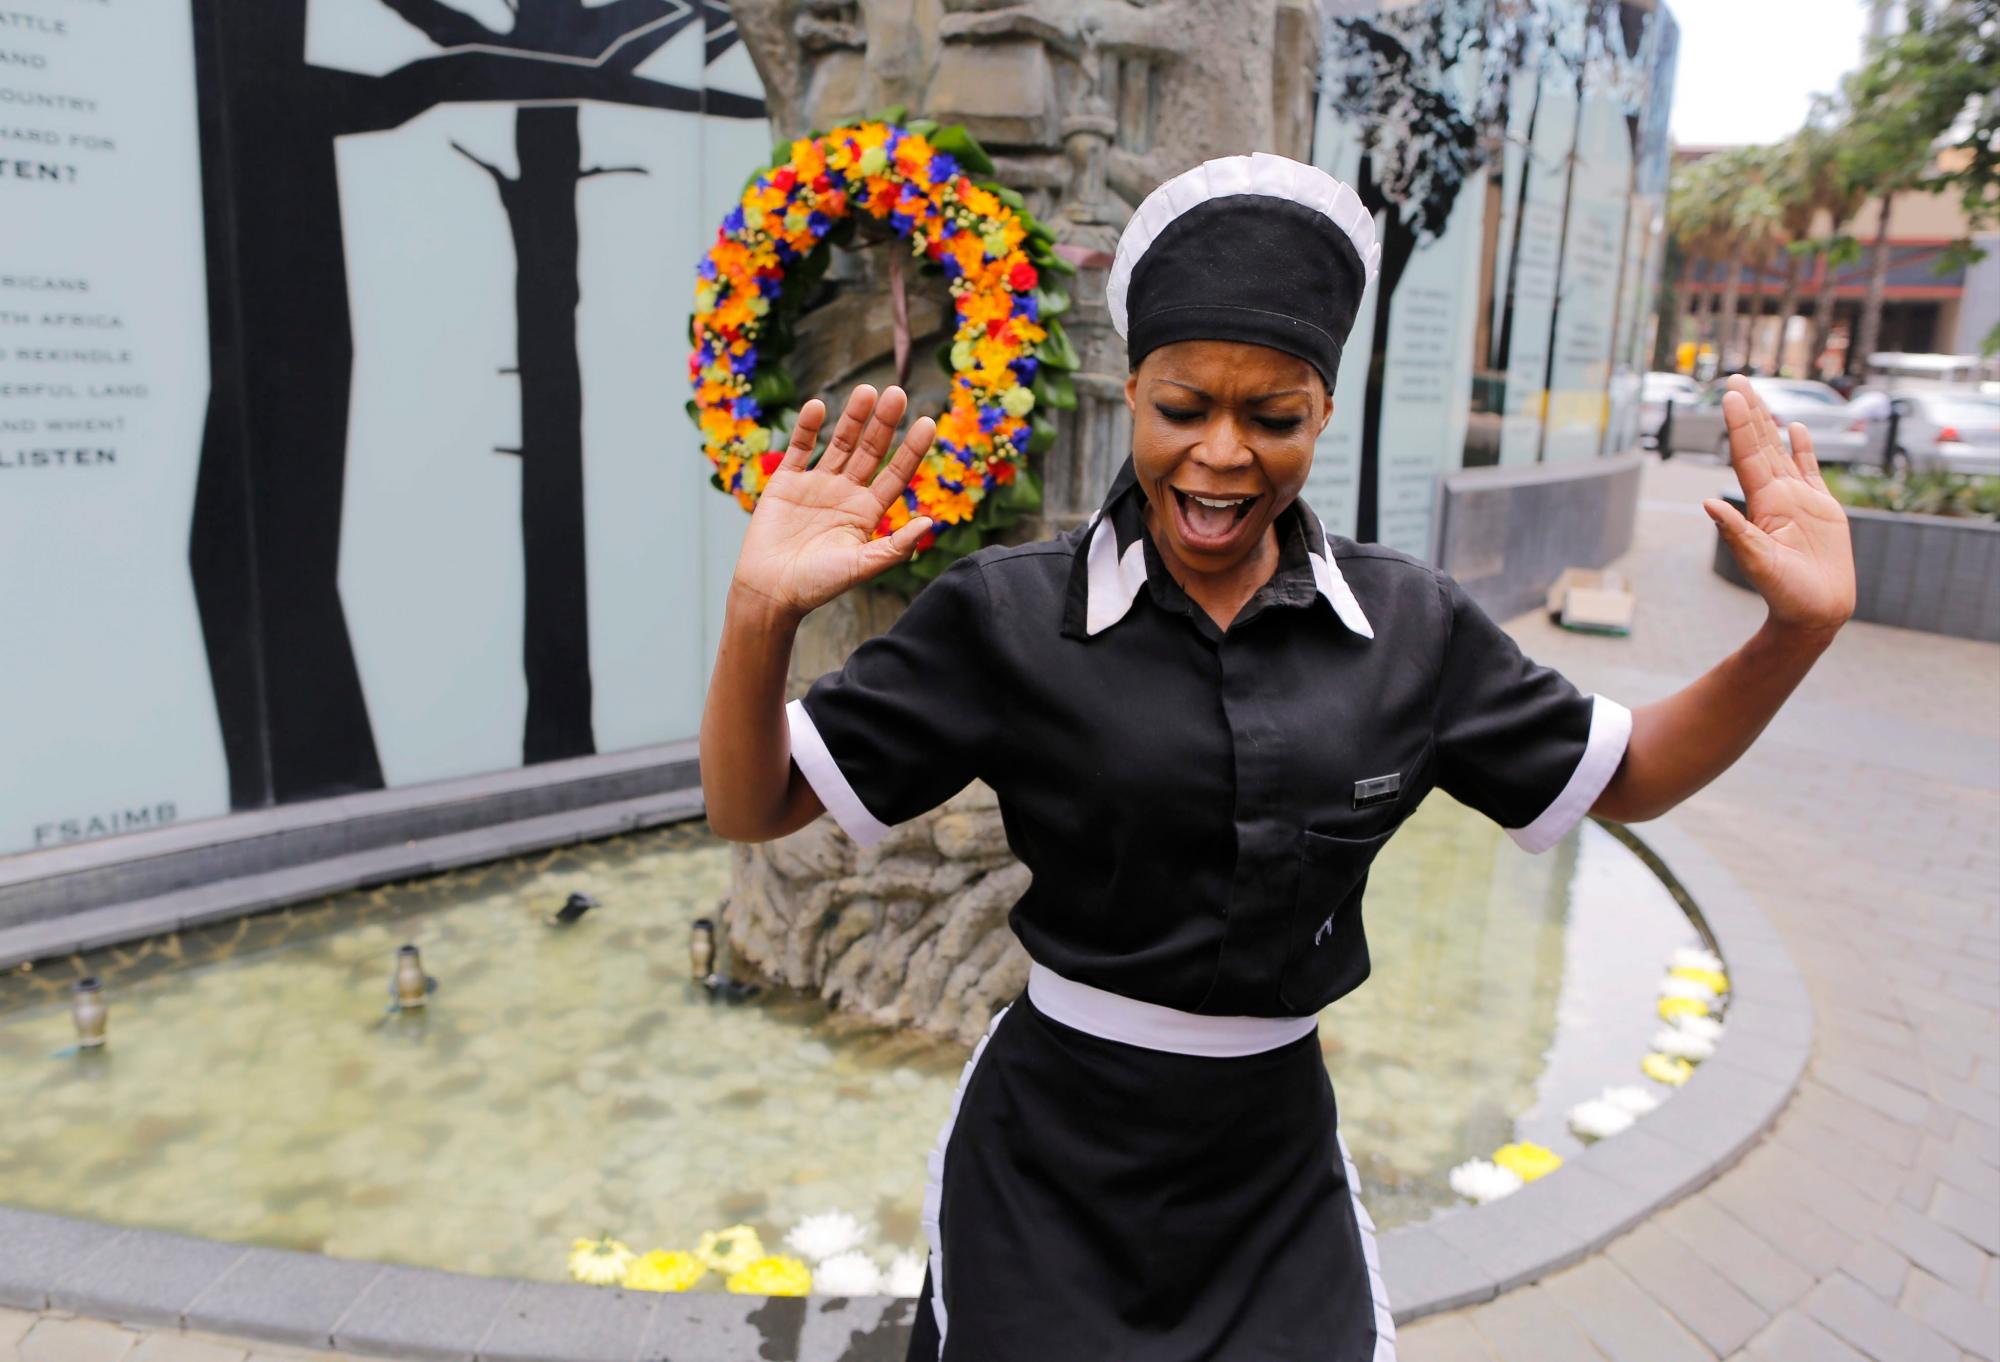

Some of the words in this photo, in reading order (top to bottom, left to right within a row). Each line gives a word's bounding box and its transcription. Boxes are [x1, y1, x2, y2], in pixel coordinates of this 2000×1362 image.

[68, 132, 116, 152] FOR
[41, 312, 123, 328] AFRICA
[88, 384, 150, 399] LAND
[45, 415, 125, 432] WHEN?
[0, 446, 117, 468] LISTEN
